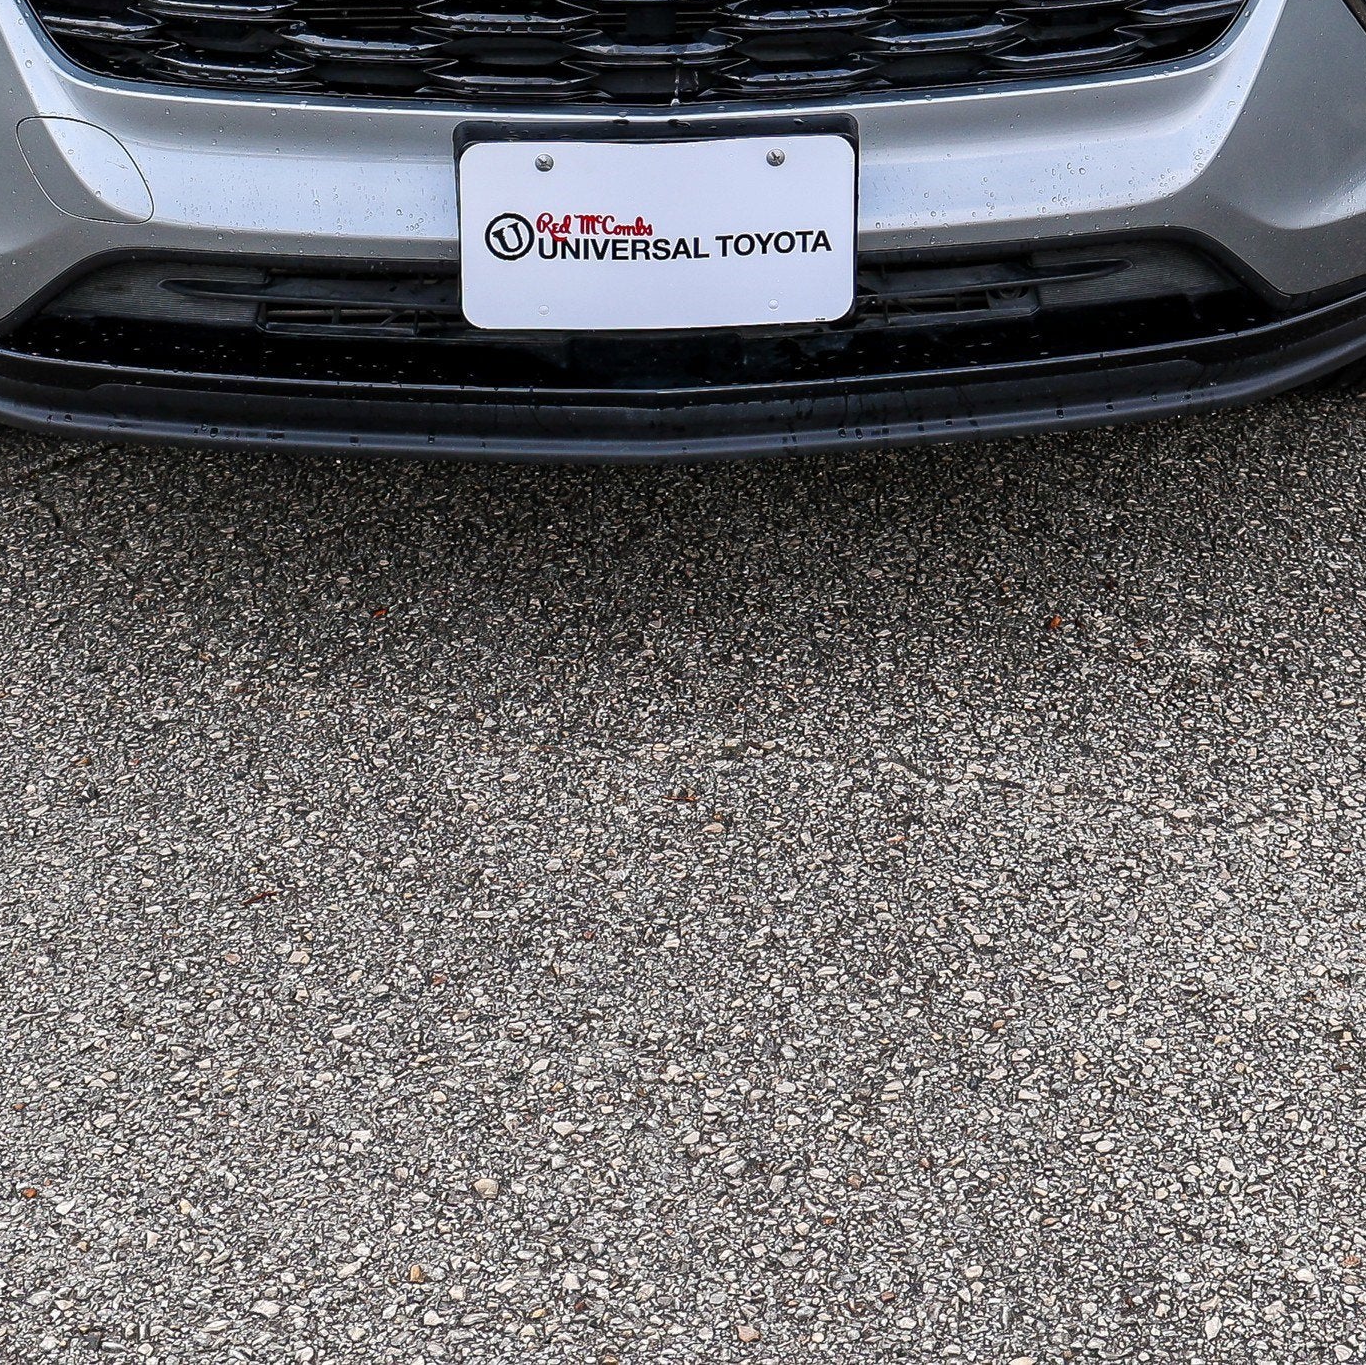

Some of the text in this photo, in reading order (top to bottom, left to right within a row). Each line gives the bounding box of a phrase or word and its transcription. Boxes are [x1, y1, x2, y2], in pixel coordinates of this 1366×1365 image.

[536, 212, 653, 241] Red McCombs
[538, 230, 833, 261] UNIVERSAL TOYOTA
